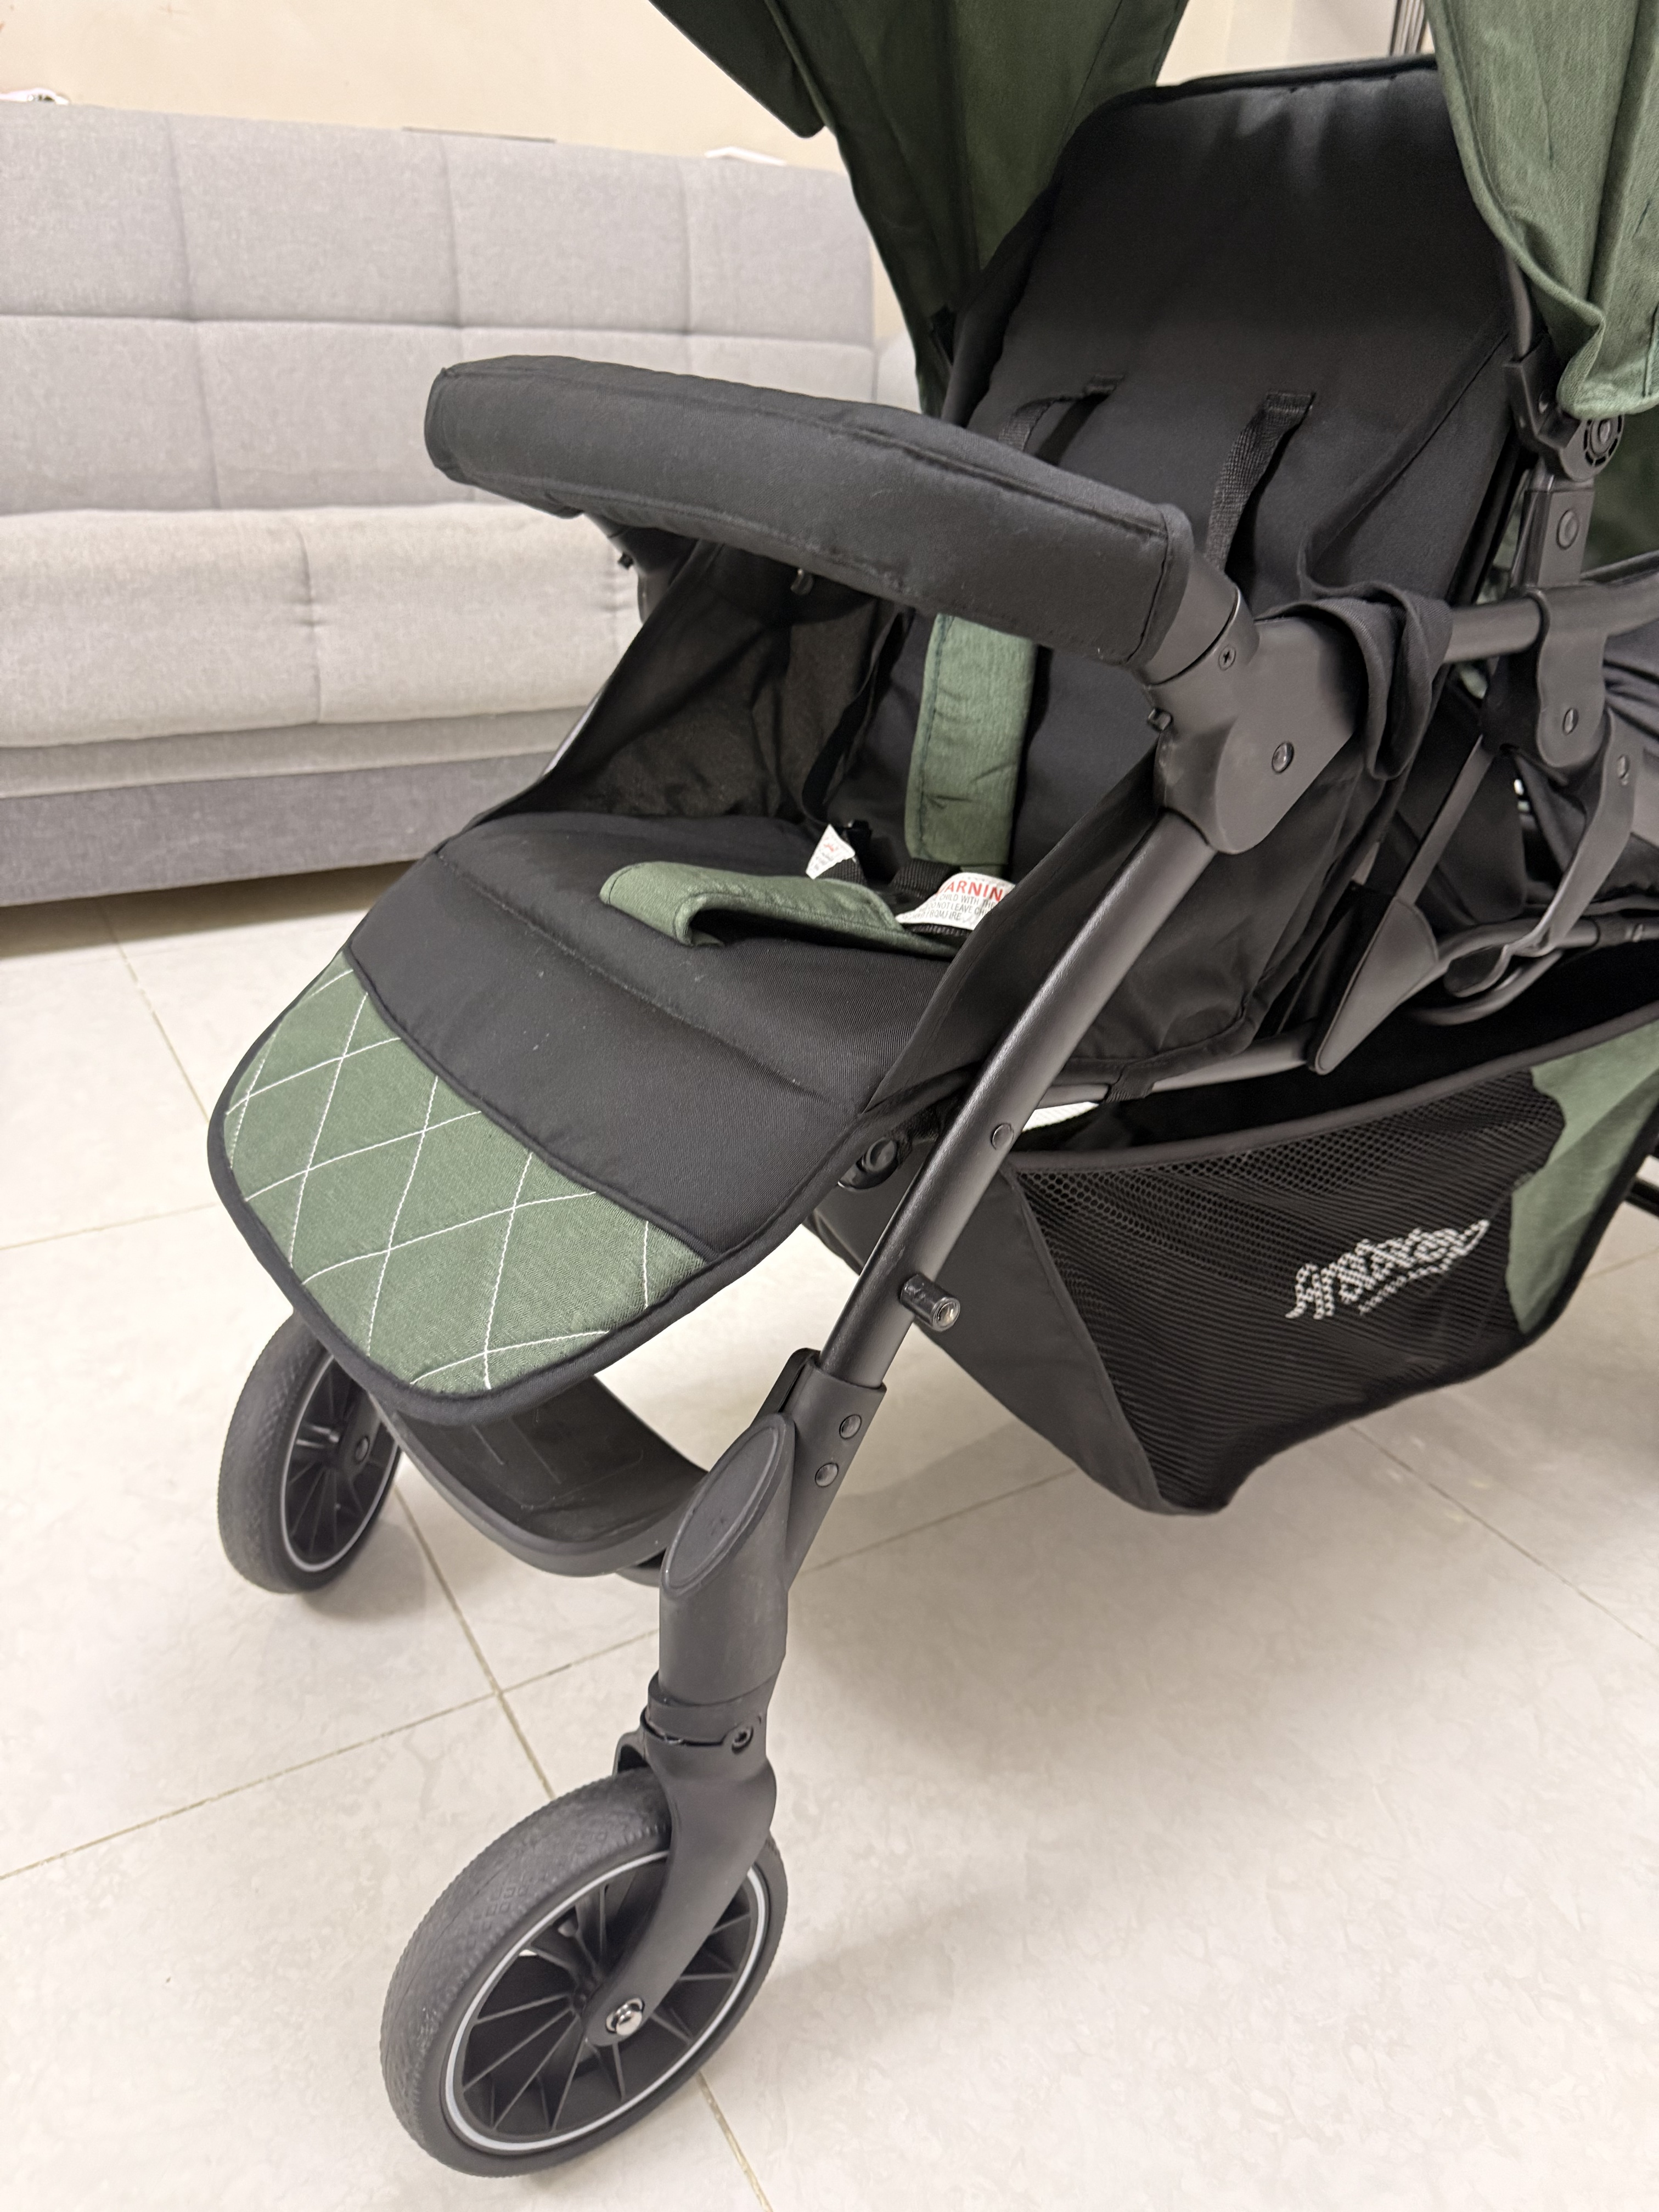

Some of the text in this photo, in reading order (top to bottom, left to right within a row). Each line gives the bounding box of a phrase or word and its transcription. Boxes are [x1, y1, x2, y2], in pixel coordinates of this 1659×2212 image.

[936, 880, 1003, 902] ARNIN
[939, 893, 958, 902] CHILD
[961, 895, 979, 905] WITH
[945, 911, 961, 920] FIRE
[951, 903, 973, 913] LEAVE
[975, 907, 987, 916] CHI
